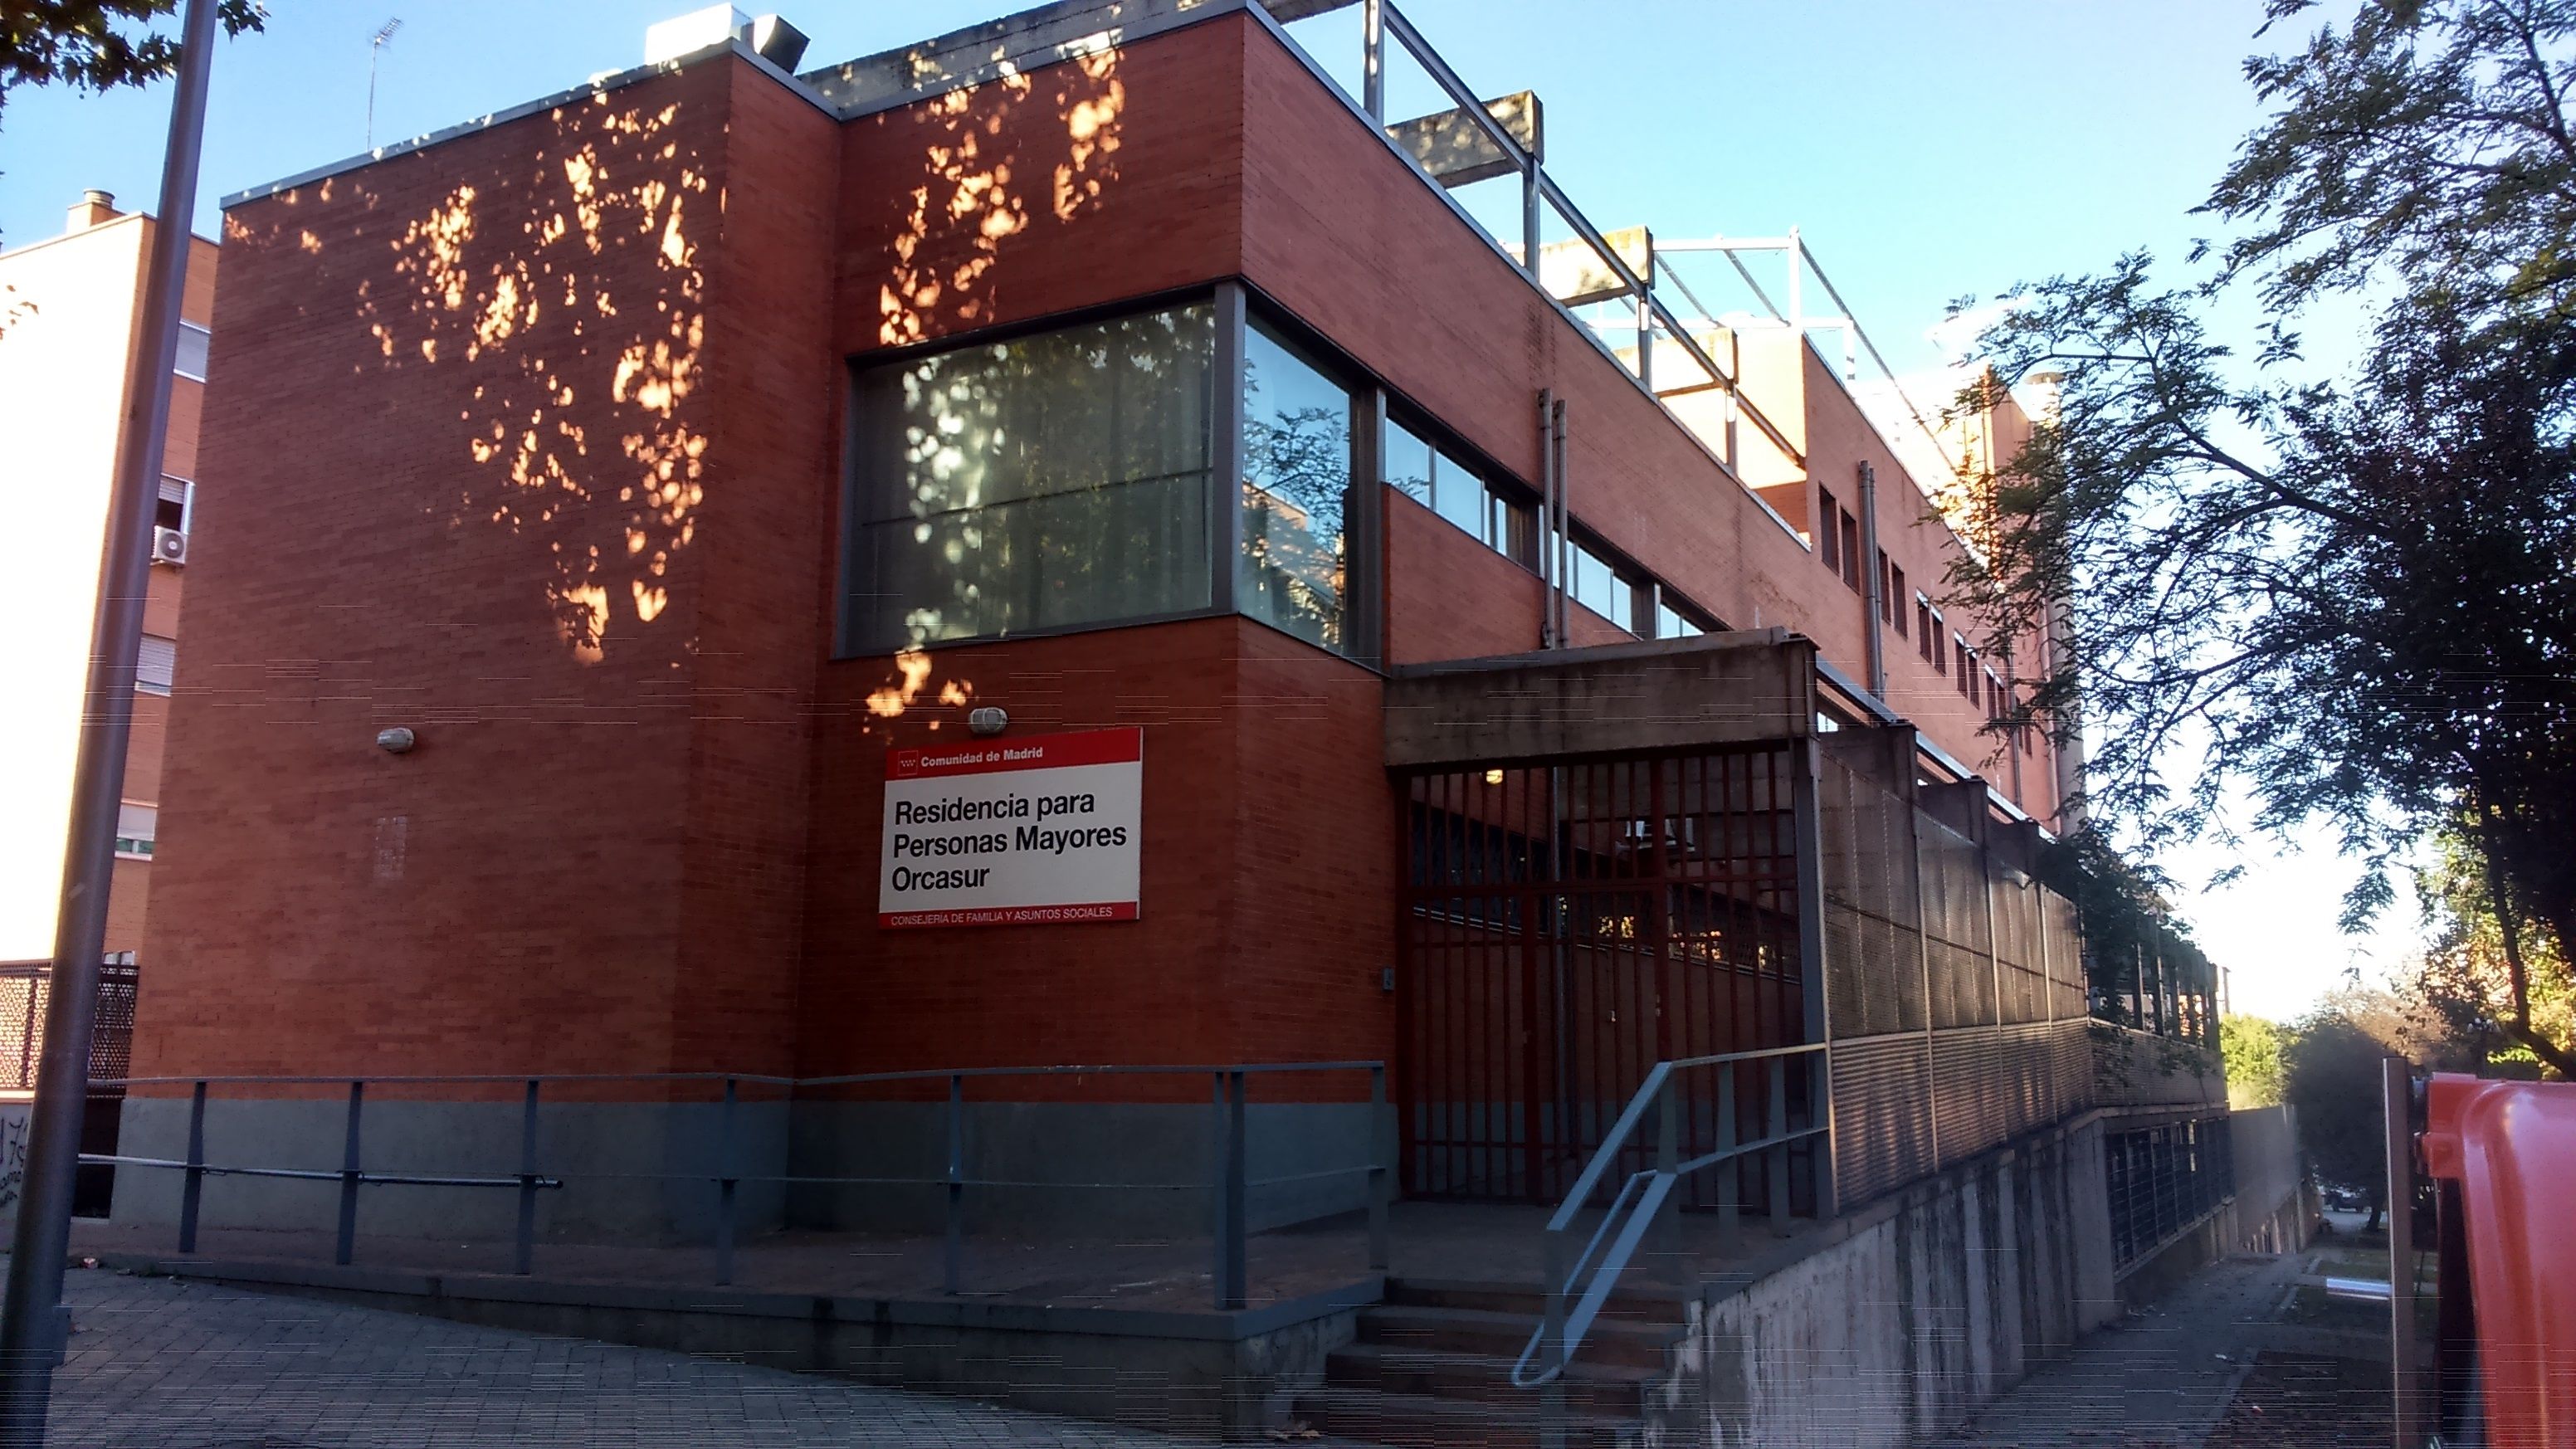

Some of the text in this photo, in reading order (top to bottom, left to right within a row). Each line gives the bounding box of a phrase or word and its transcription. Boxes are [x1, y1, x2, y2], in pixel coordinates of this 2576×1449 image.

[921, 747, 1043, 767] Comunidad de Madrid
[895, 793, 1095, 825] Residencia para
[894, 825, 1127, 858] Personas Mayores
[892, 867, 990, 891] Orcasur
[951, 913, 964, 923] DE
[966, 912, 1003, 922] FAMILIA
[1006, 911, 1012, 920] Y
[1014, 909, 1061, 920] ASUNTOS
[1063, 906, 1113, 919] SOCIALES
